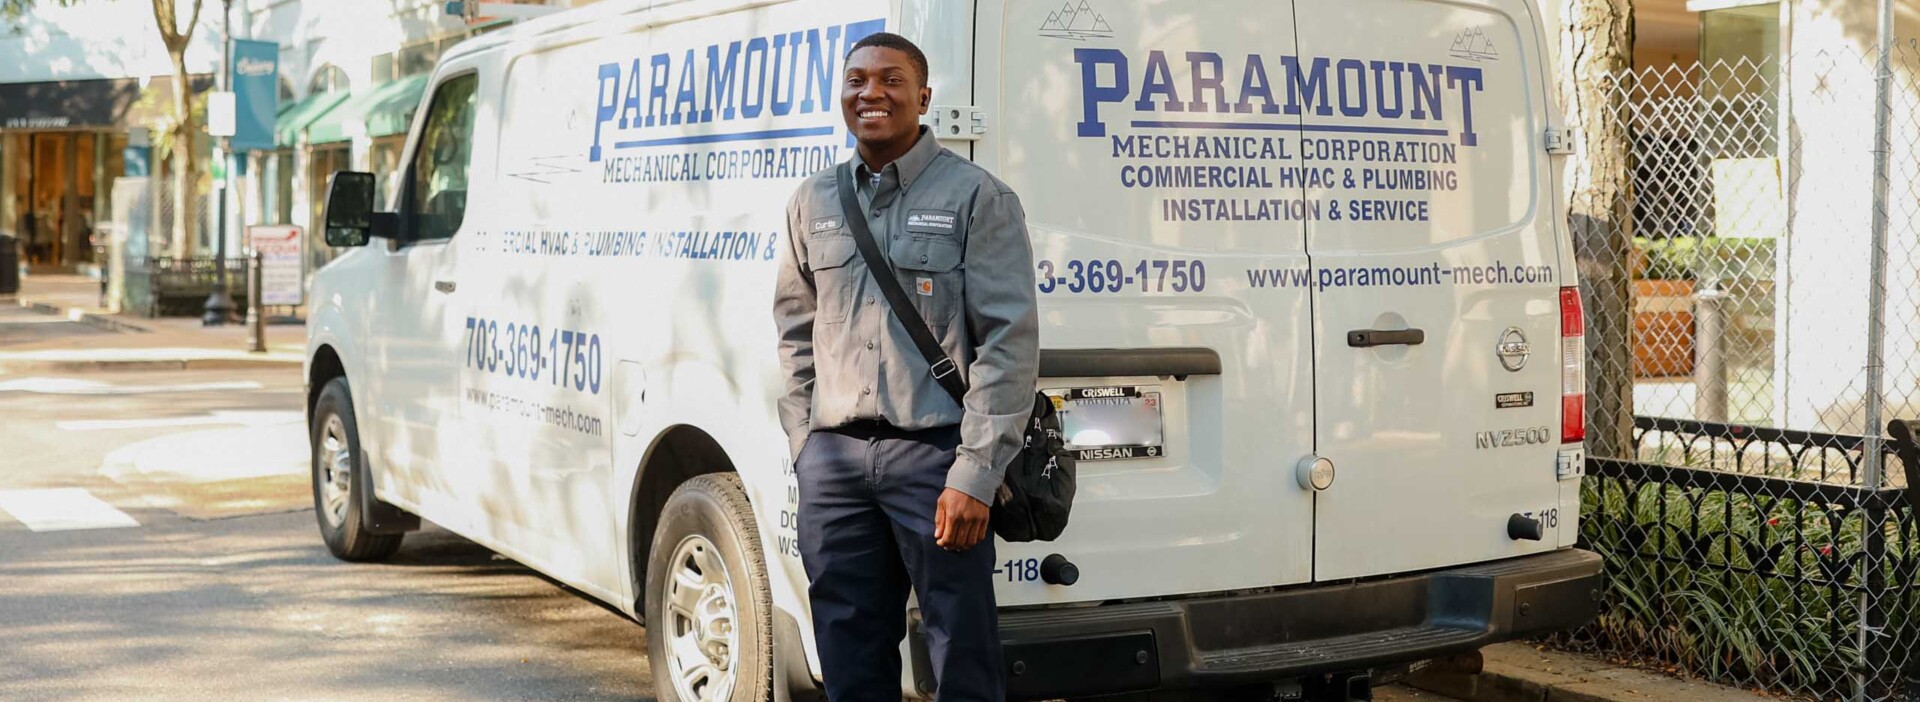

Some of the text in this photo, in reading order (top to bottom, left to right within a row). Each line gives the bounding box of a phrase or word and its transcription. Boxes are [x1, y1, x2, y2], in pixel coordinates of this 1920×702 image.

[1073, 47, 1483, 147] PARAMOUNT
[603, 144, 838, 184] MECHANICAL CORPORATION
[1111, 135, 1457, 164] MECHANICAL CORPORATION
[1120, 164, 1458, 191] COMMERCIAL HVAC & PLUMBING
[1162, 198, 1429, 222] INSTALLATION & SERVICE
[540, 231, 570, 256] HVAC
[583, 230, 647, 257] PLUMBING
[649, 231, 762, 261] INSTALLATION
[762, 231, 778, 261] &
[1037, 259, 1553, 294] 3-369-1750 www.paramount-mech.com
[466, 317, 602, 396] 703-369-1750
[1502, 344, 1530, 353] NISSAN
[1475, 426, 1550, 449] NV2500
[1079, 447, 1133, 460] NISSAN
